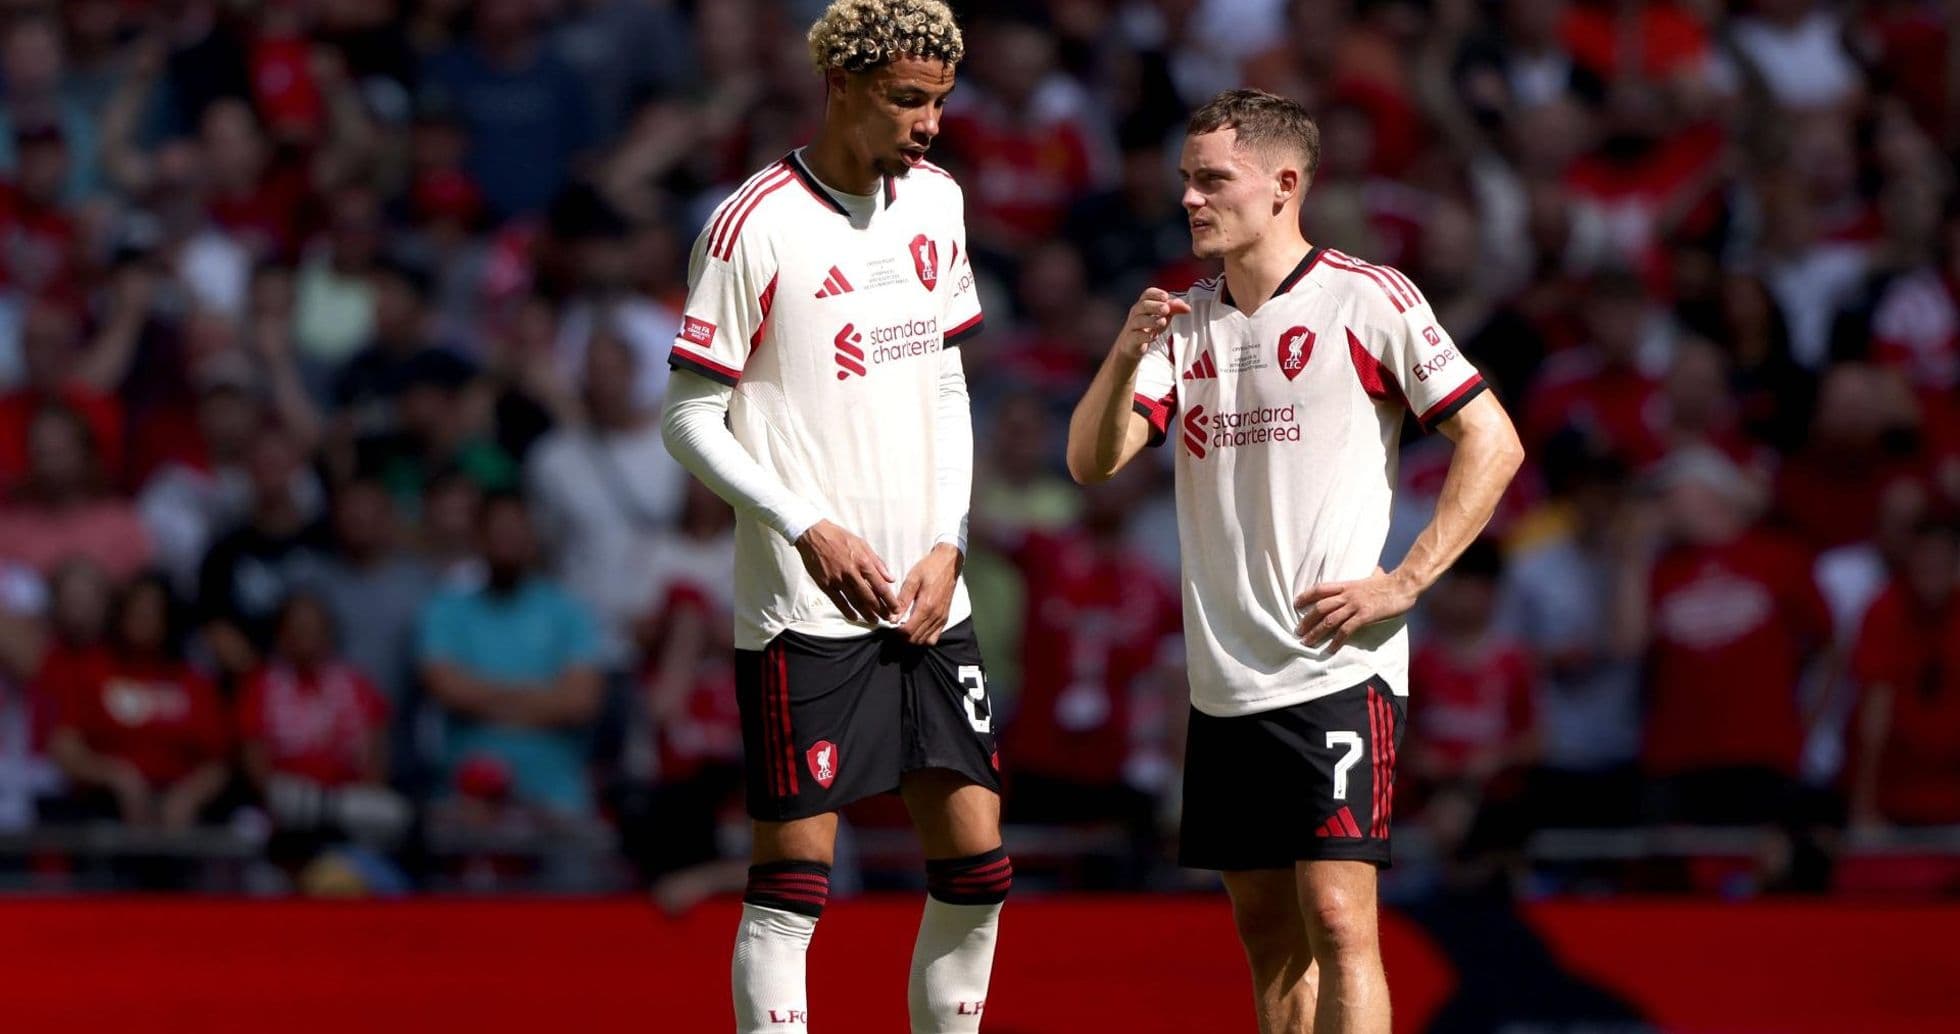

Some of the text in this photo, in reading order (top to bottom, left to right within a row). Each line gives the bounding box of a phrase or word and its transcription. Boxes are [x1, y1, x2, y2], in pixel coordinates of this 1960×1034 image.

[870, 314, 936, 345] standard
[1212, 403, 1294, 429] standard
[1213, 424, 1300, 448] chartered
[1326, 731, 1363, 800] 7
